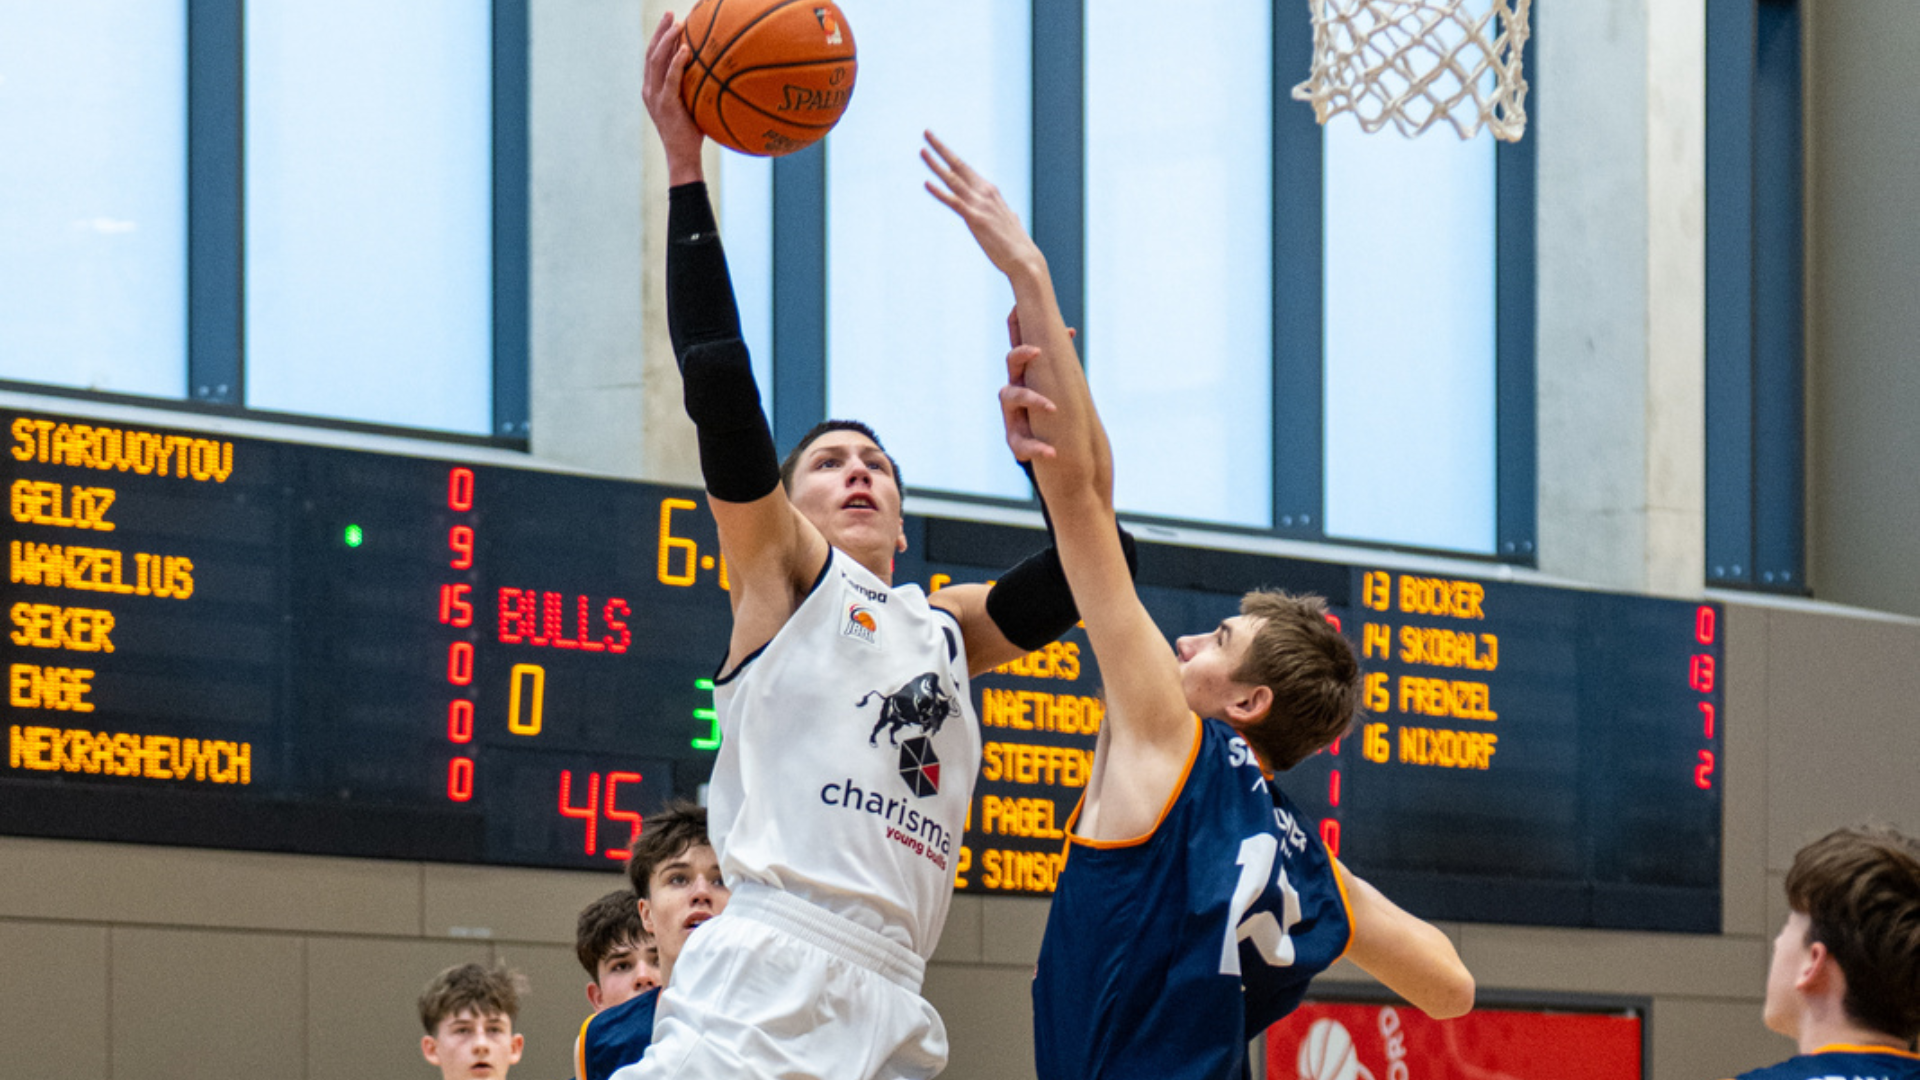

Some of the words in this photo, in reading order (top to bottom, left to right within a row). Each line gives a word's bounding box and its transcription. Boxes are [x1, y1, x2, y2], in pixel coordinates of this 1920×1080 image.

[11, 417, 235, 483] STAROVOYTOV
[448, 466, 476, 512] 0
[11, 540, 195, 600] WANZELIUS
[449, 524, 476, 571] 9
[439, 582, 475, 628] 15
[1363, 570, 1392, 612] 13
[10, 601, 117, 653] SEKER
[498, 586, 633, 654] BULLS
[1363, 622, 1392, 660] 14
[1696, 605, 1717, 646] 0
[448, 640, 476, 686] 0
[1689, 653, 1717, 694] 13
[10, 663, 97, 713] ENGE
[508, 663, 547, 736] 0
[1363, 671, 1391, 713] 15
[1399, 675, 1499, 722] FRENZEL
[448, 698, 476, 744] 0
[1698, 701, 1716, 740] 7
[1363, 722, 1391, 764] 16
[1399, 726, 1499, 770] NIXDORF
[448, 756, 476, 802] 0
[1695, 749, 1716, 790] 2
[558, 769, 644, 862] 45
[820, 778, 951, 856] charisma
[982, 794, 1065, 839] PAGEL
[885, 825, 925, 856] young
[953, 845, 973, 889] 2
